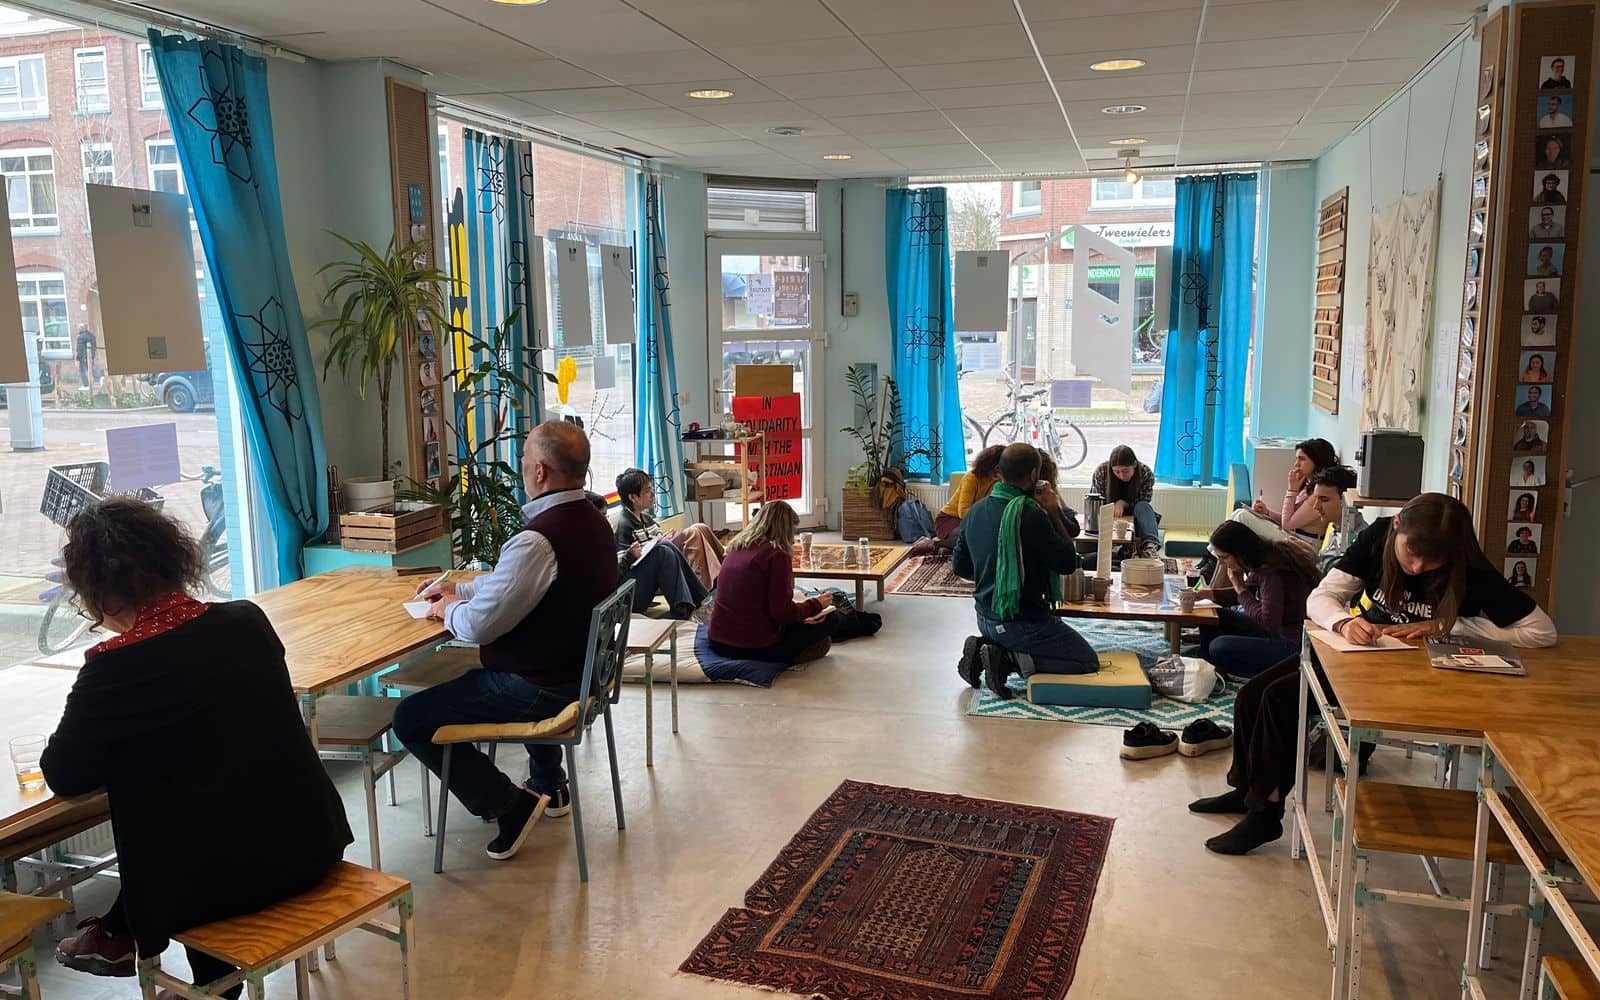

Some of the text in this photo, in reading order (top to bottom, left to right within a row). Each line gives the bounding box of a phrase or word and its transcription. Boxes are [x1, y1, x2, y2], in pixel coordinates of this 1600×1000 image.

[1096, 225, 1171, 239] Tweewielers
[1088, 268, 1120, 278] NDERHOUD
[762, 396, 772, 410] IN
[741, 417, 798, 433] OLIDARITY
[774, 440, 793, 454] THE
